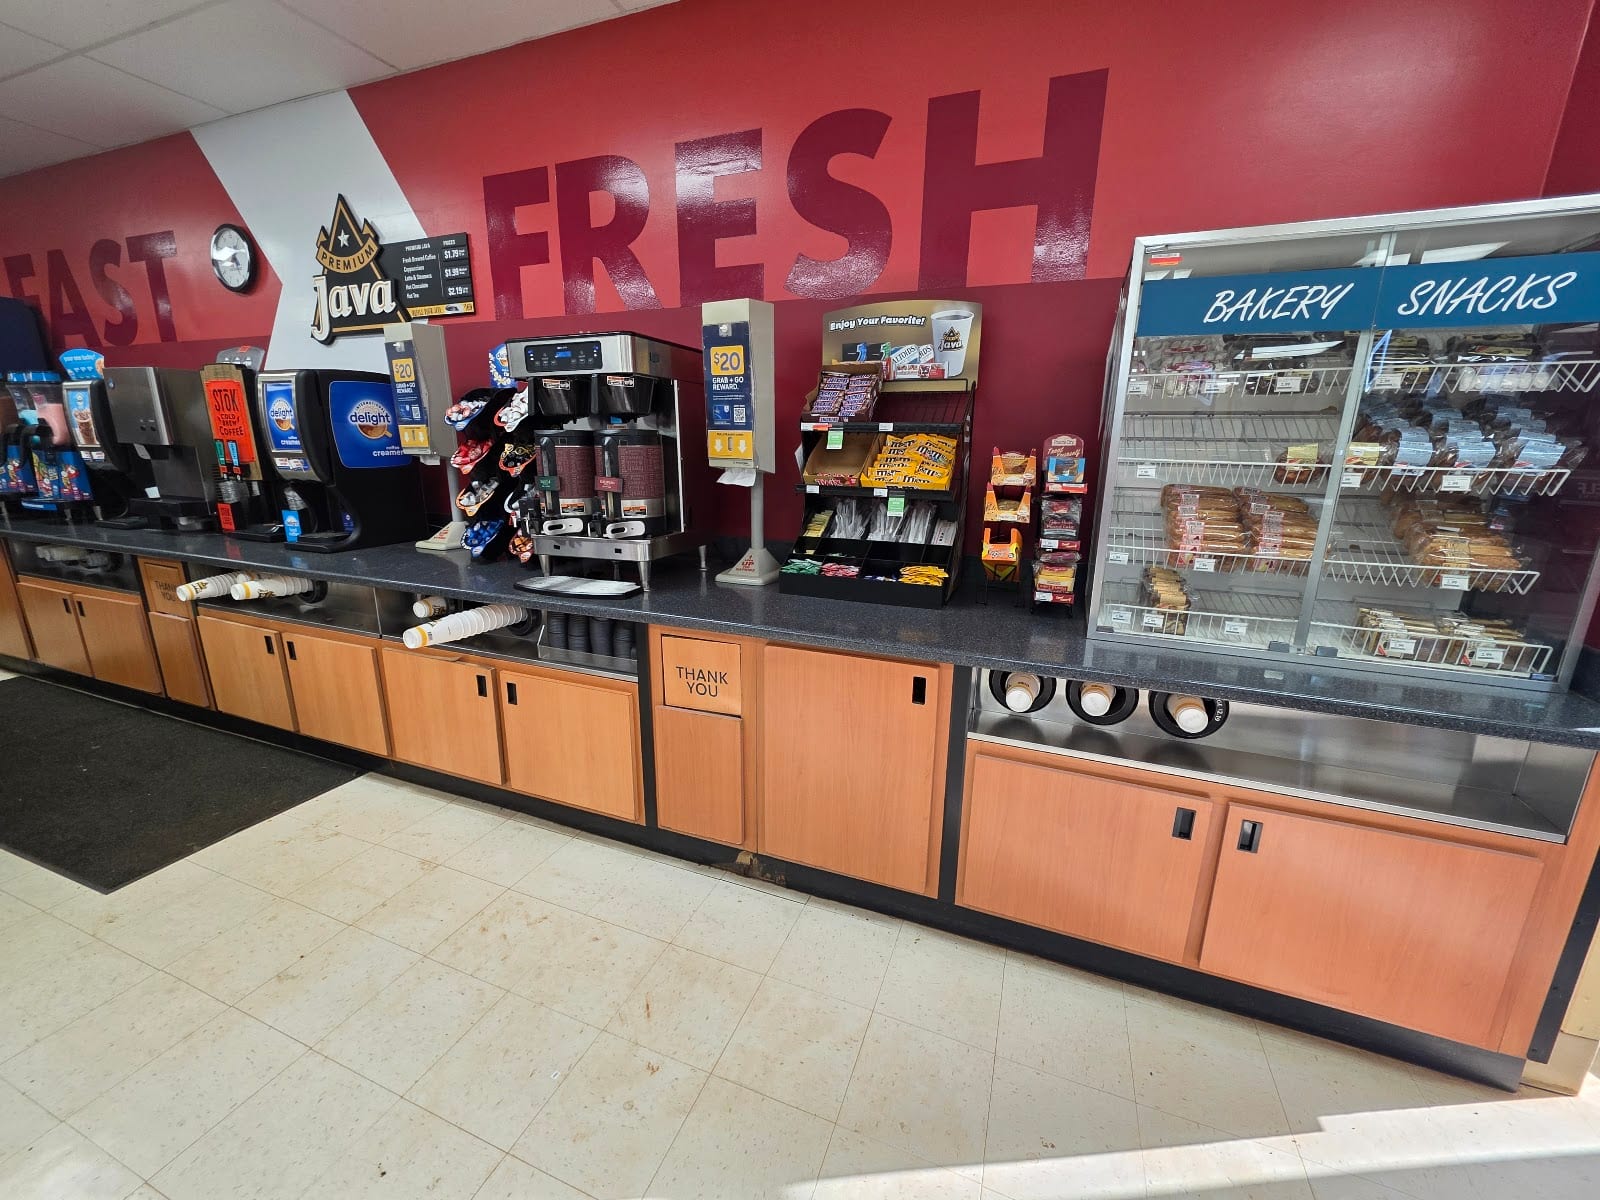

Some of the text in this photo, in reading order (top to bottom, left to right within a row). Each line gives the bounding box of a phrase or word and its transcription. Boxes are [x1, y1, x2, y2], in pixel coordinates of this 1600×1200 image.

[483, 68, 1109, 320] FRESH
[320, 243, 375, 271] PREMIUM
[444, 249, 458, 259] $1.79
[3, 230, 178, 348] FAST
[1397, 271, 1578, 316] SNACKS
[311, 275, 396, 341] Java
[1203, 283, 1355, 324] BAKERY
[829, 314, 926, 331] Enjoy Your Favorite!
[713, 352, 741, 372] $20
[394, 363, 412, 379] $20
[712, 376, 729, 384] GRAB
[269, 408, 294, 420] delight
[349, 412, 391, 425] delight
[219, 426, 244, 436] COFFEE
[154, 580, 177, 592] THAN
[675, 666, 728, 685] THANK
[686, 681, 718, 698] YOU
